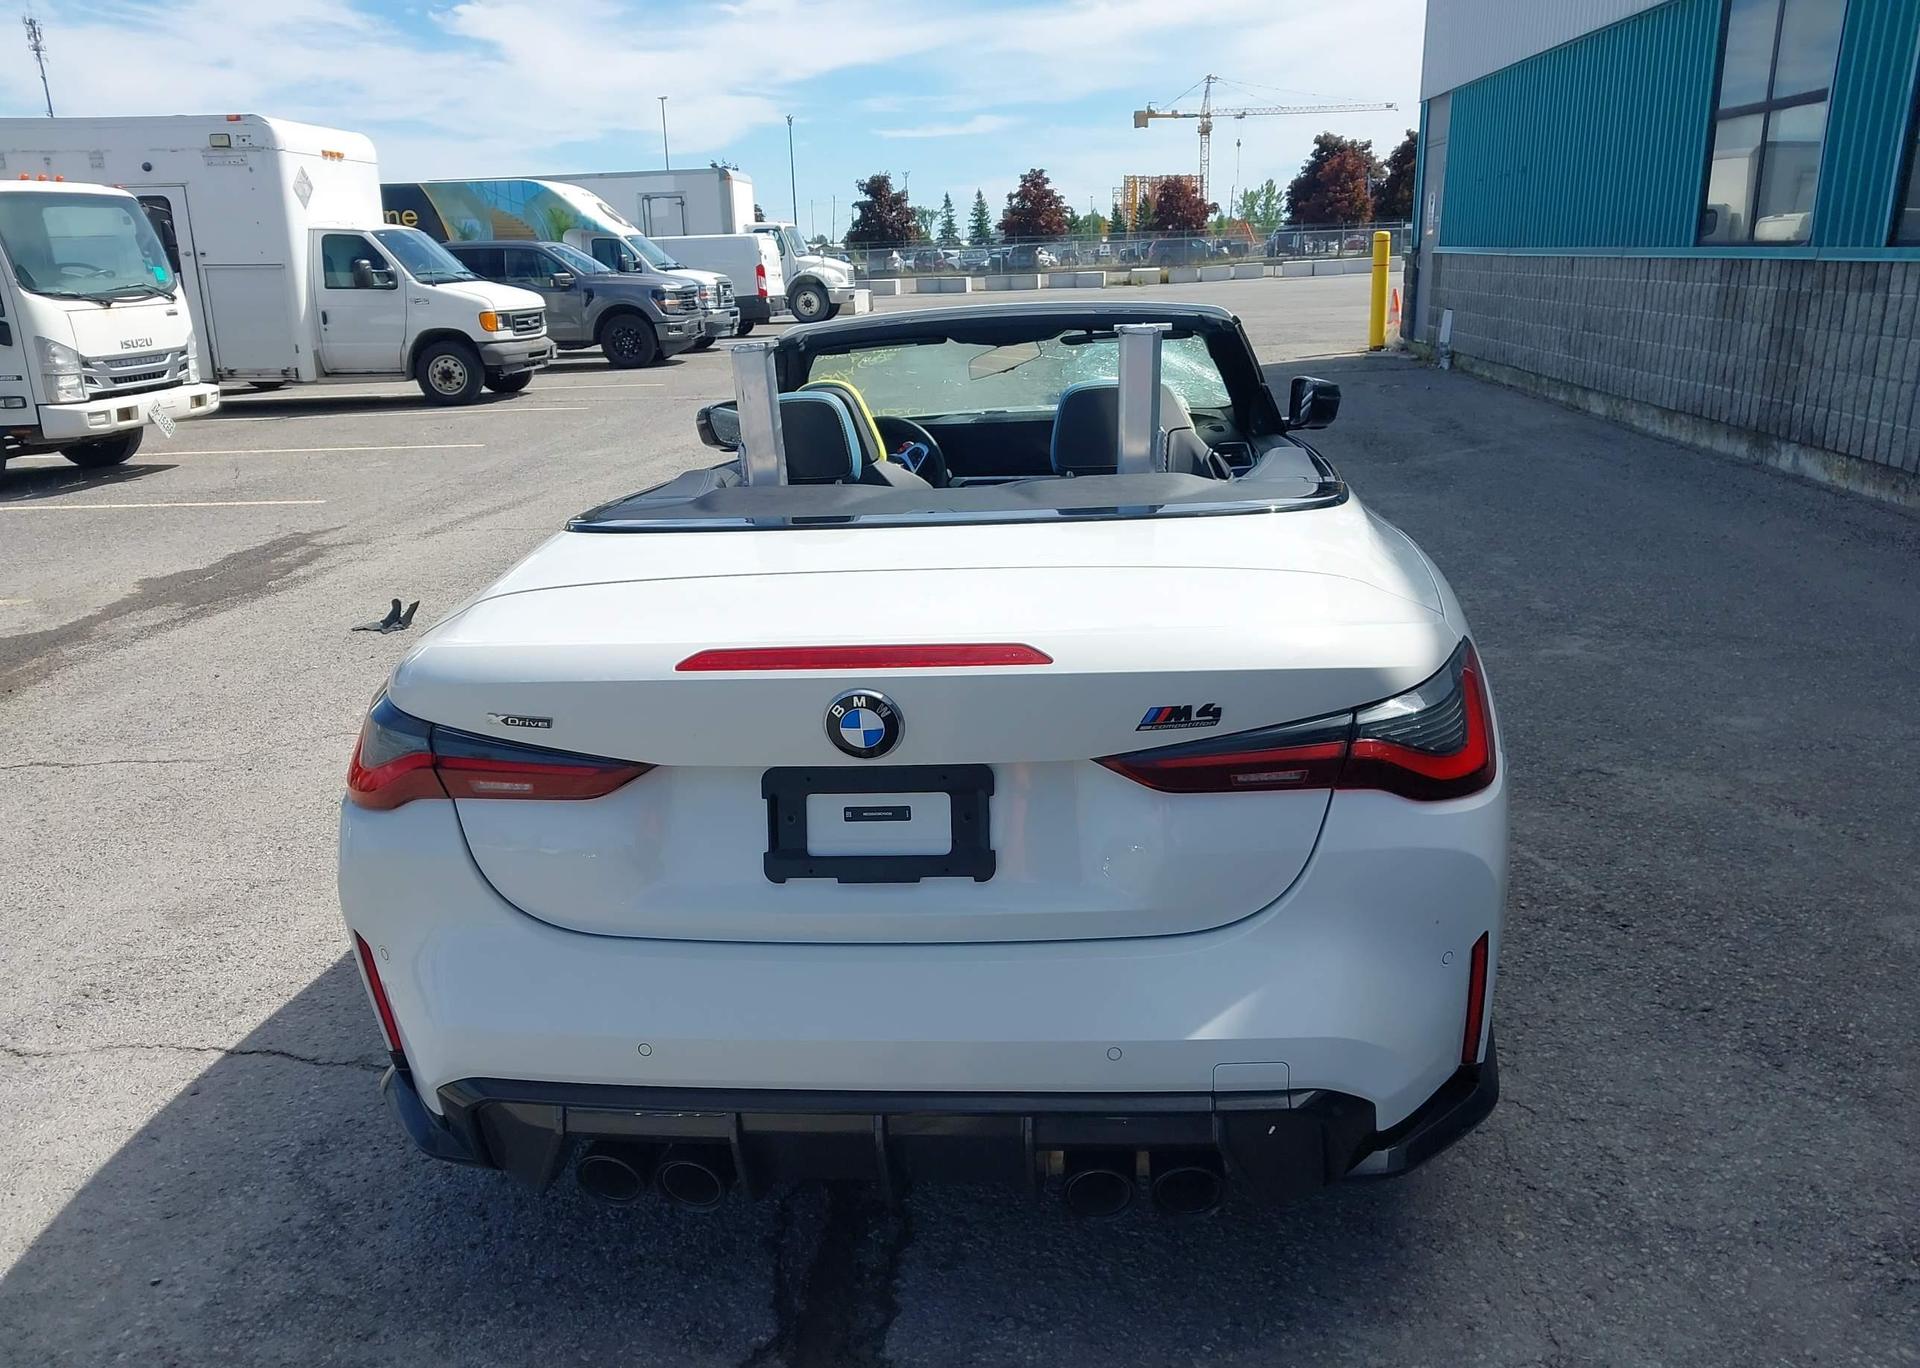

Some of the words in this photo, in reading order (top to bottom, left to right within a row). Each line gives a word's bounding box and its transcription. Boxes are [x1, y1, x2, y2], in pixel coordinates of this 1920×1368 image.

[120, 337, 153, 350] ISUZU
[831, 696, 892, 718] BMW
[1162, 702, 1222, 721] M4
[1151, 720, 1219, 730] competition
